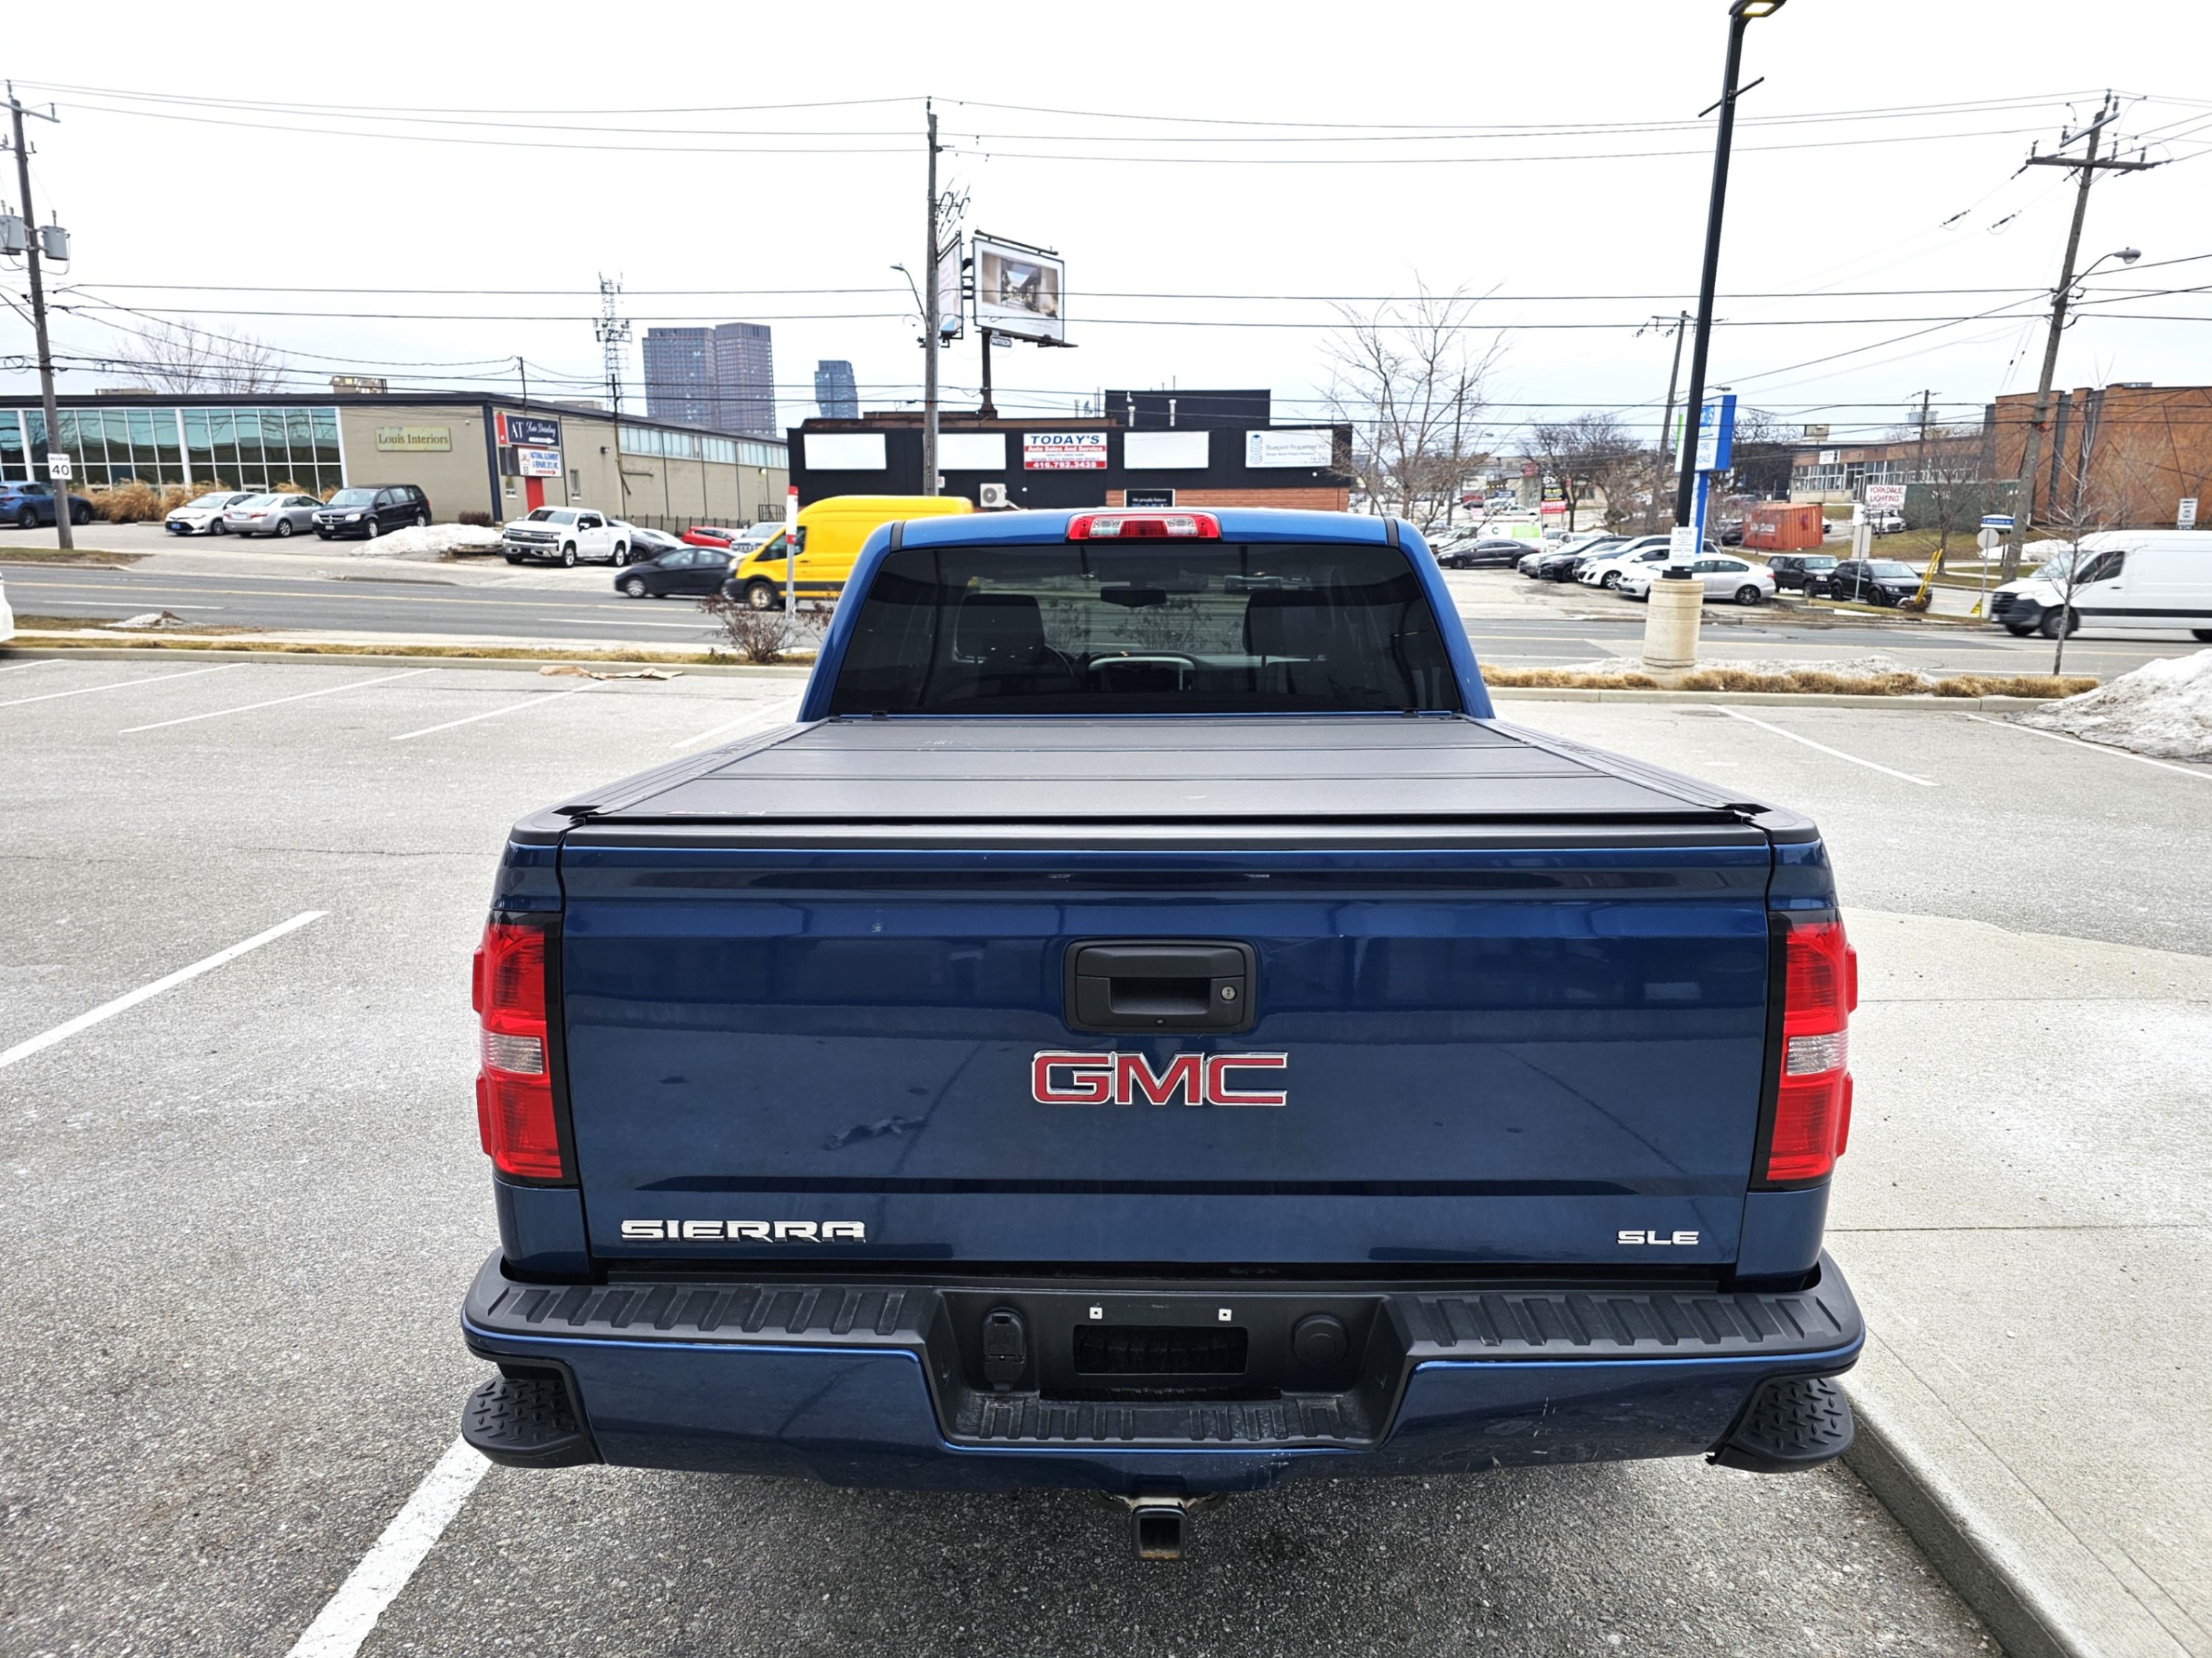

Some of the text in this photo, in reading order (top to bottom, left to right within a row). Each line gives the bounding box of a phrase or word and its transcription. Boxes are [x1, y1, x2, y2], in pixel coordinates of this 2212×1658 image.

[510, 422, 524, 438] AT
[378, 433, 449, 444] Louis Interiors
[1030, 435, 1100, 445] TODAY'S
[52, 465, 69, 475] 40
[1032, 1050, 1288, 1106] GMC
[621, 1220, 866, 1243] SIERRA
[1617, 1230, 1699, 1245] SLE
